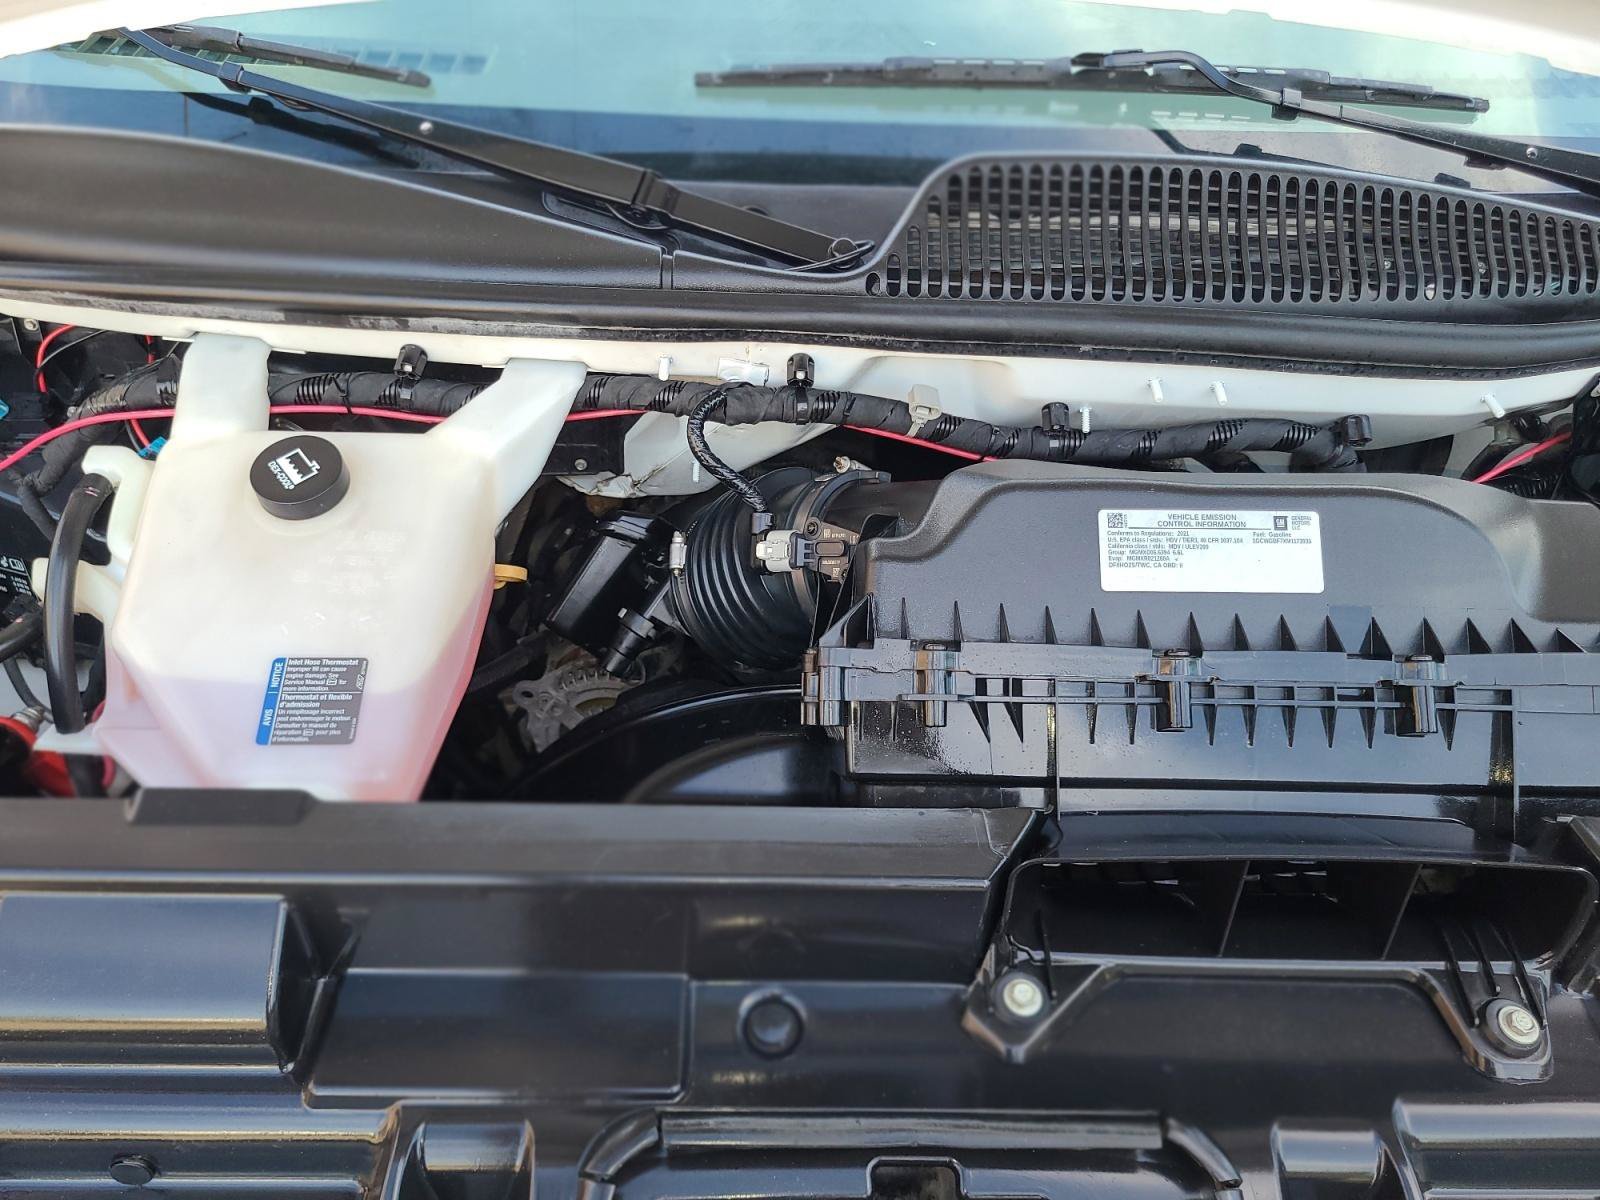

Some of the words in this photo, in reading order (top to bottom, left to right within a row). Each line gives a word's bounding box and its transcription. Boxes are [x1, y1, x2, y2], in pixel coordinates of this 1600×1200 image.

[1201, 513, 1237, 521] EMISSION
[1157, 520, 1194, 528] CONTROL
[1195, 520, 1247, 528] INFORMATION
[270, 662, 284, 688] NOTICE
[262, 708, 274, 726] AVIS
